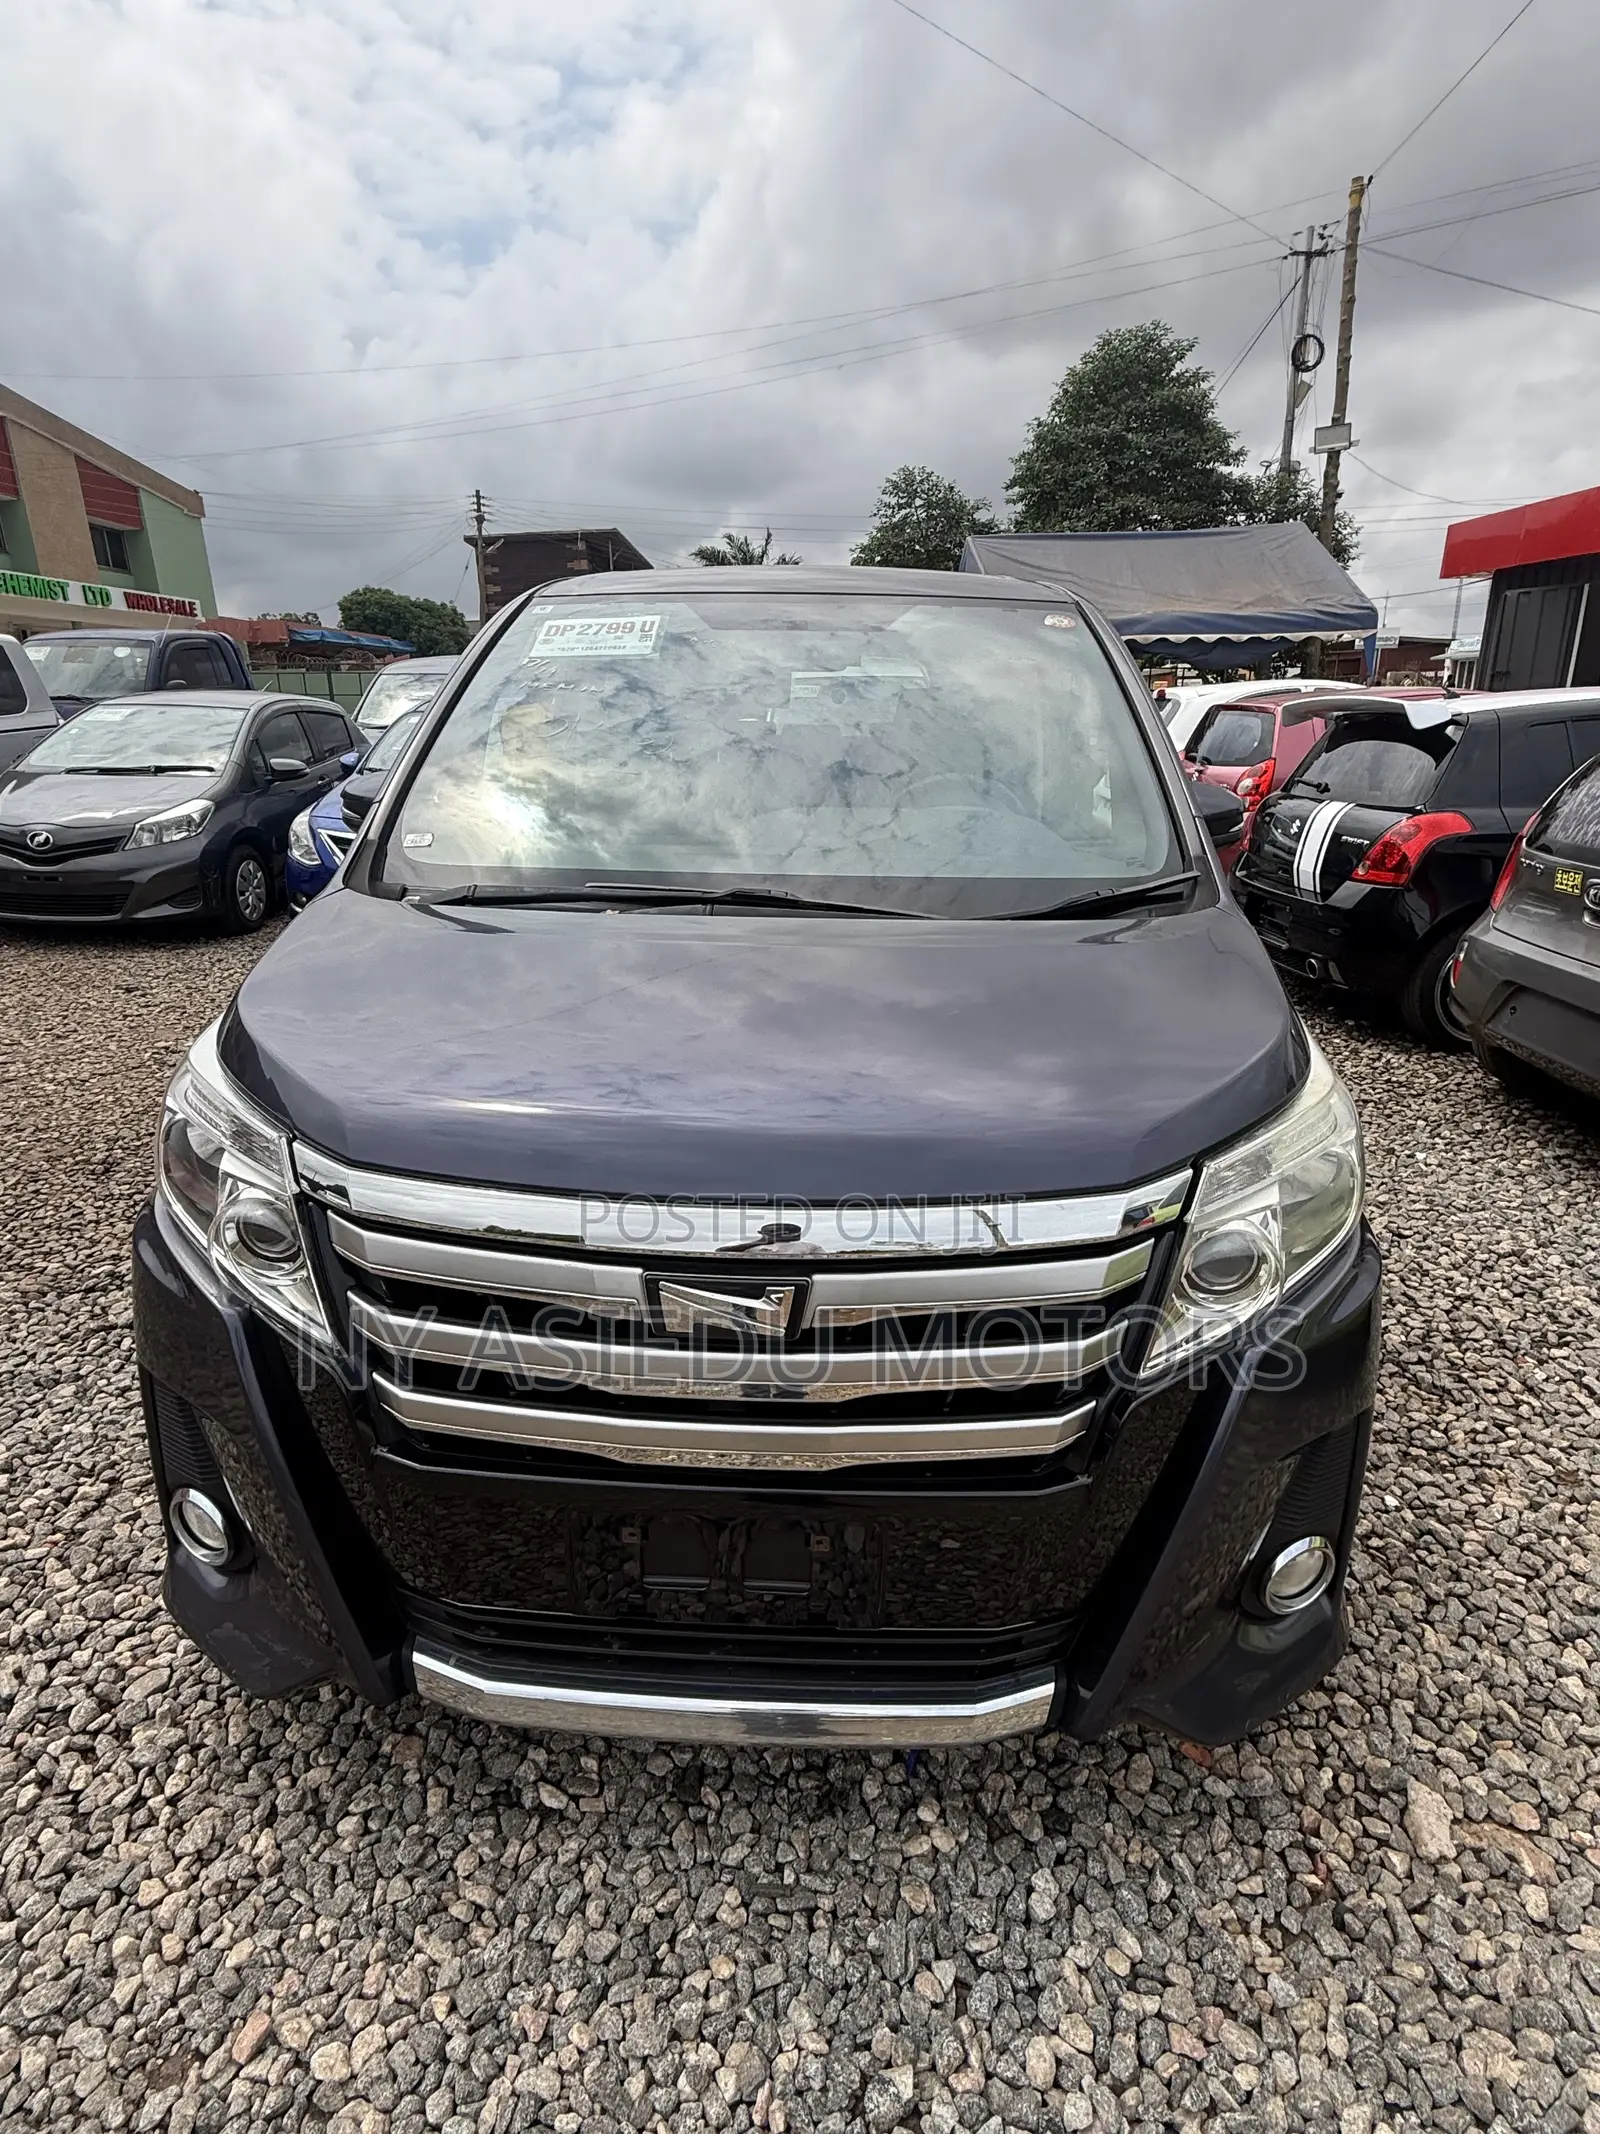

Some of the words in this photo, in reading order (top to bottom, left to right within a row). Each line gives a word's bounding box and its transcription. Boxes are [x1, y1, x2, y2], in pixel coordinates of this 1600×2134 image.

[81, 584, 113, 607] LTD
[123, 591, 198, 618] WHOLESALE
[545, 624, 576, 637] DP
[576, 621, 636, 636] 2799
[639, 620, 656, 634] U
[1341, 836, 1370, 847] SWIFT
[1556, 870, 1581, 893] 초보운전
